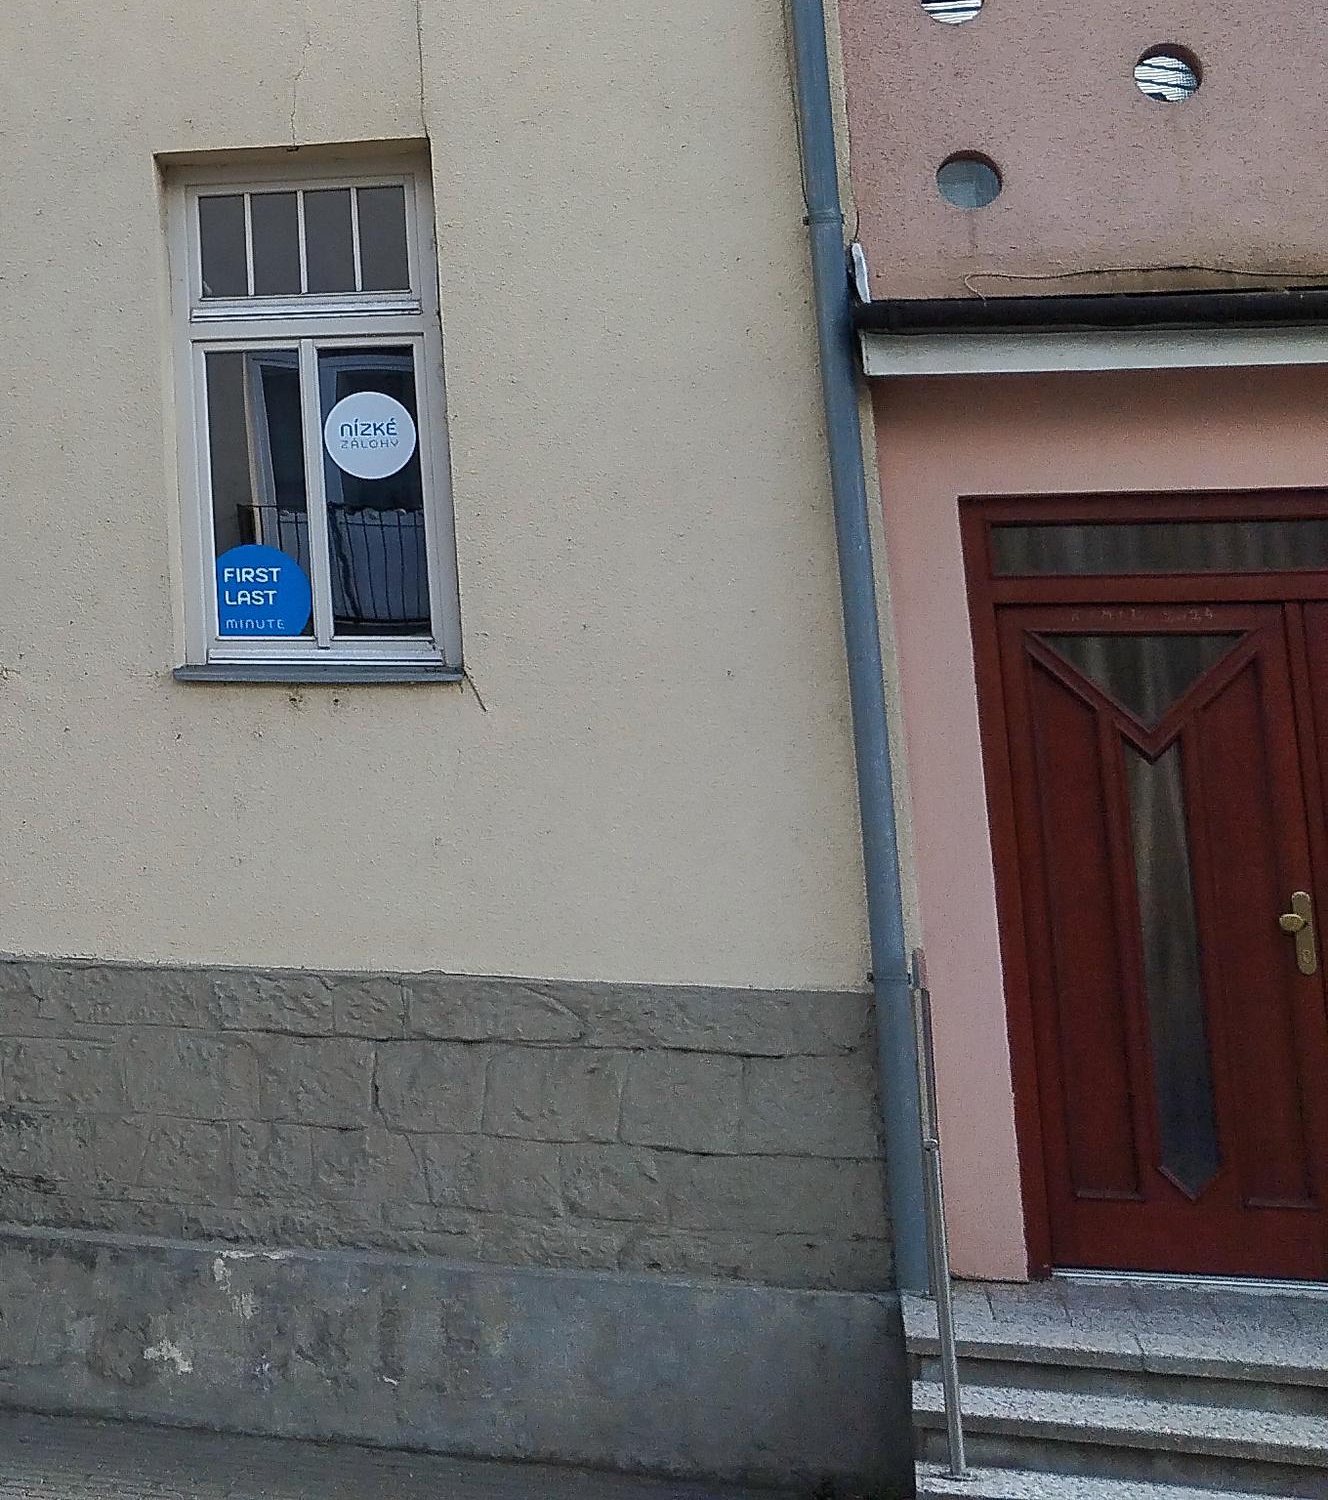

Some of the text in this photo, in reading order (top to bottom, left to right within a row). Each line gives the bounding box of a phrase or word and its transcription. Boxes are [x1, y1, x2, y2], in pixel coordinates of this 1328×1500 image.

[340, 417, 398, 437] NÍZKÉ
[340, 438, 399, 449] ZÁLOHY
[223, 567, 282, 583] FIRST
[224, 590, 278, 606] LAST
[225, 618, 286, 630] MINUTE
